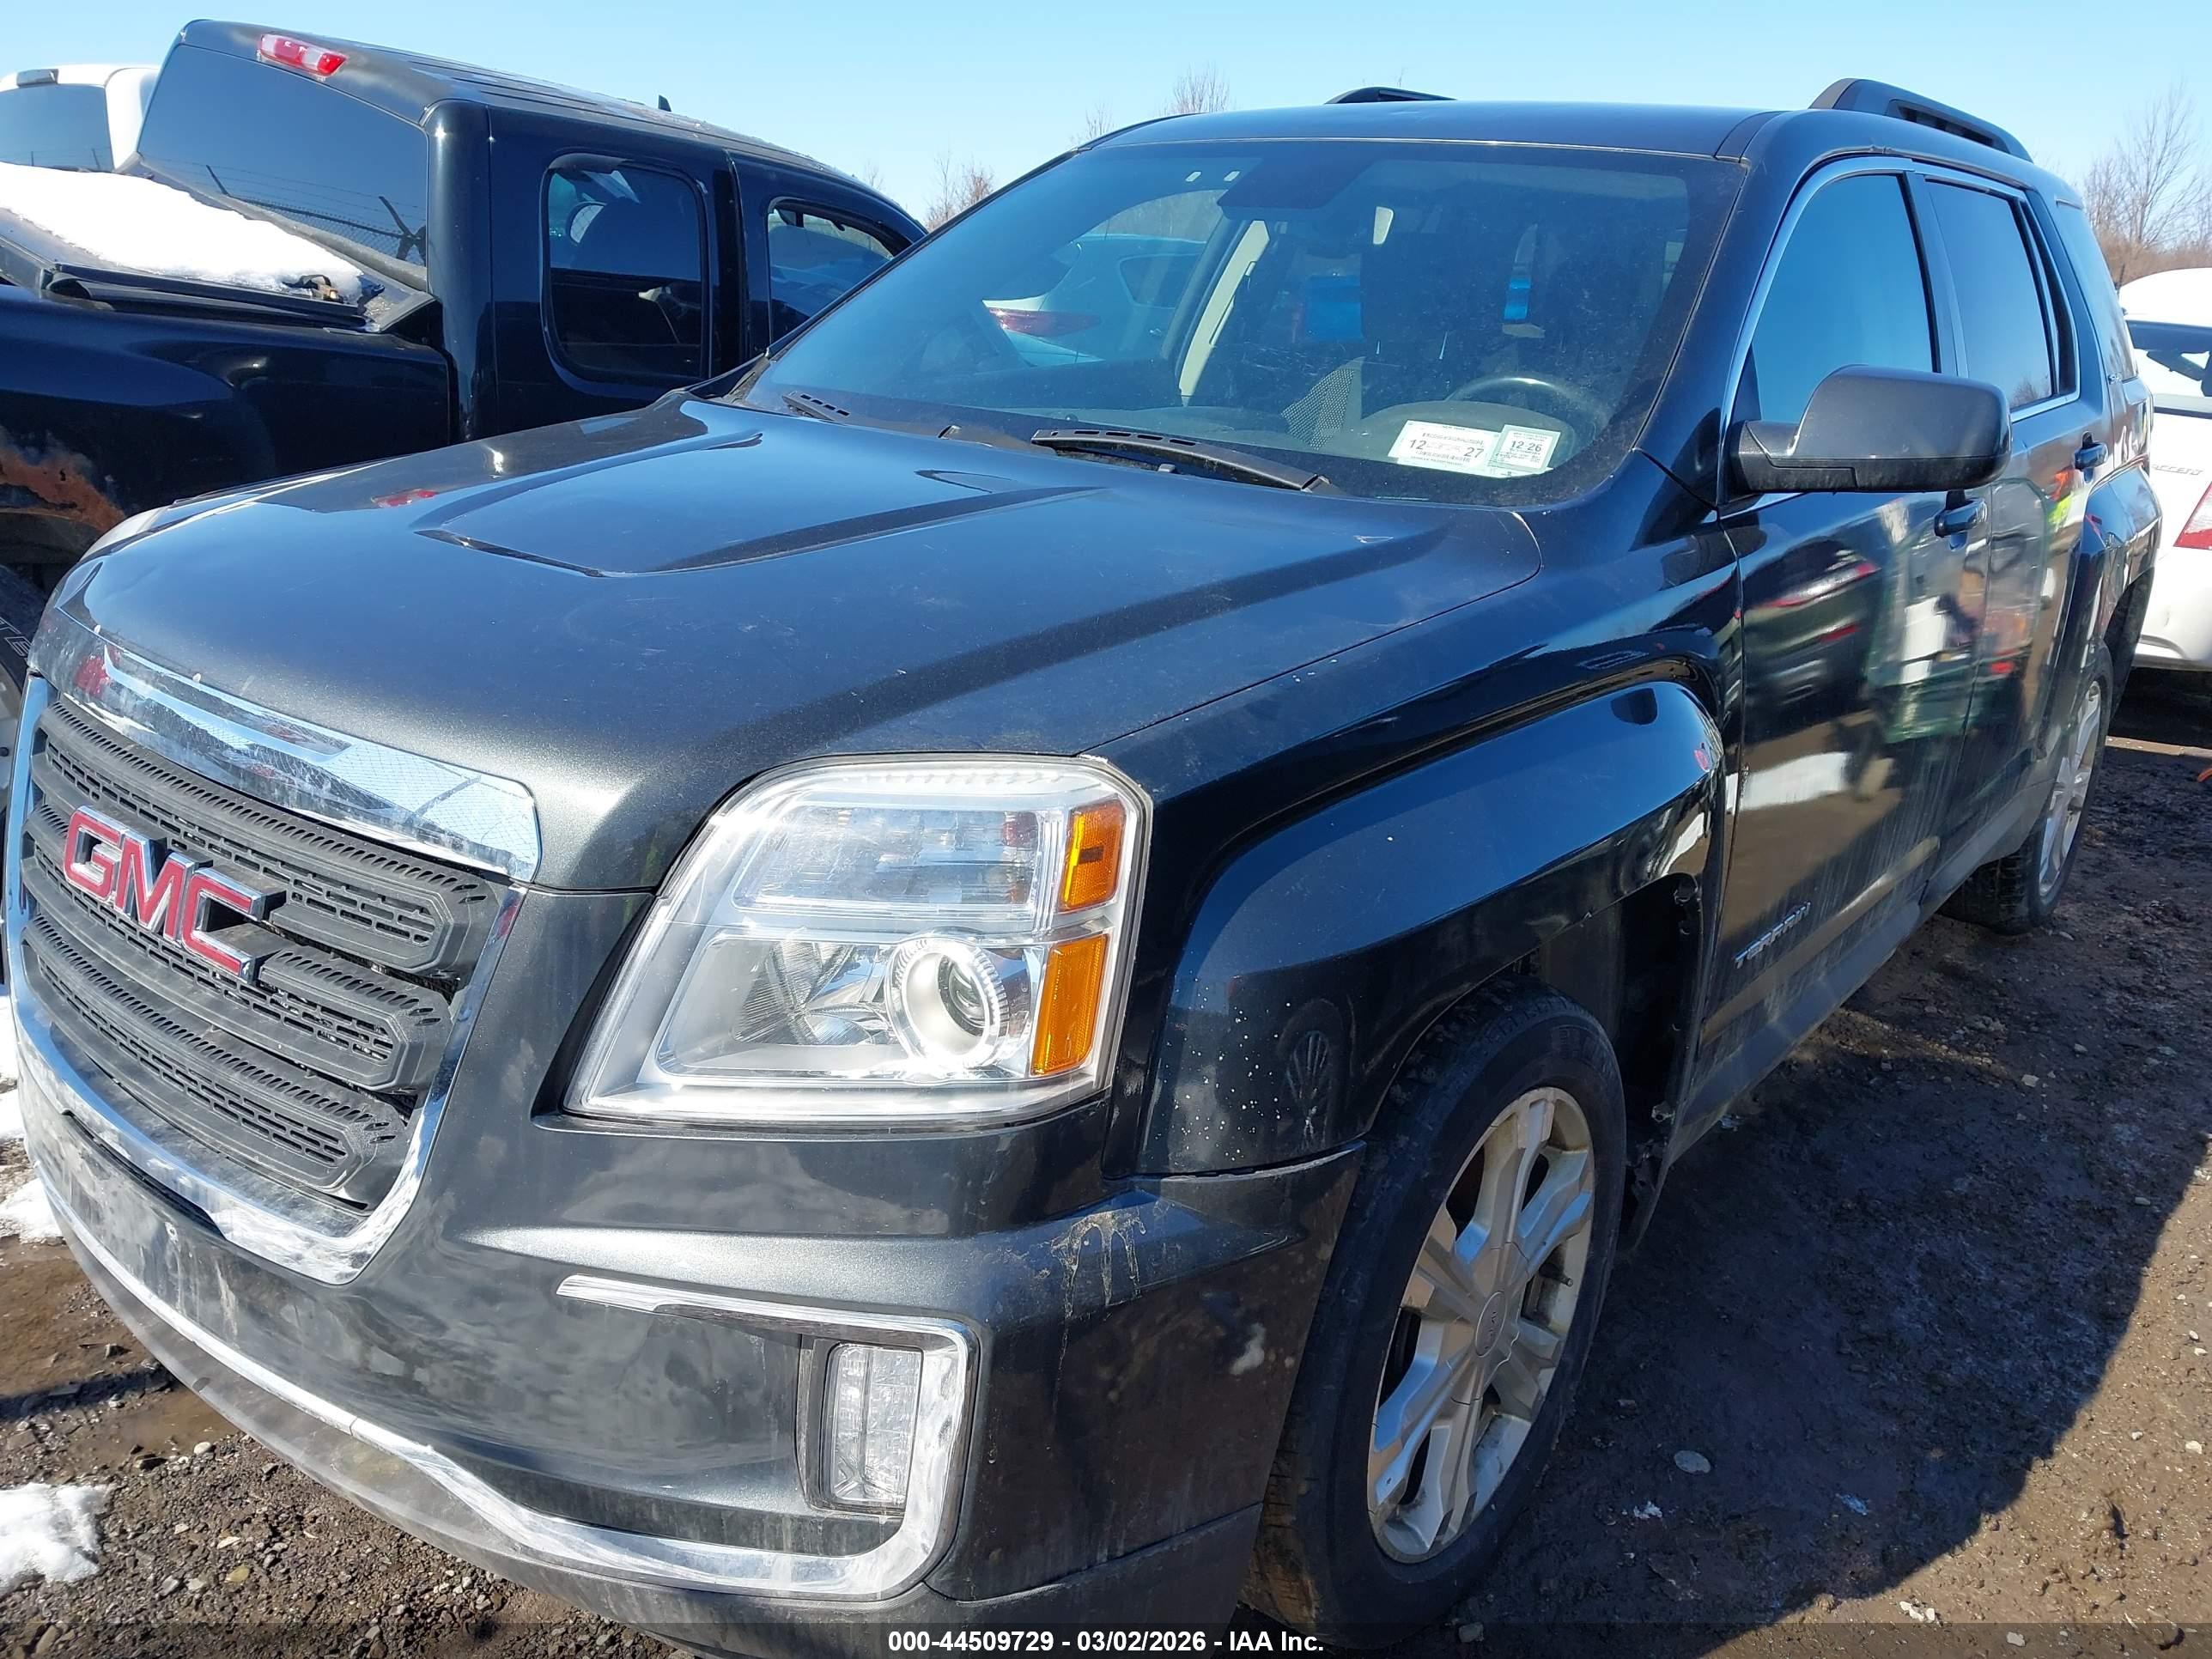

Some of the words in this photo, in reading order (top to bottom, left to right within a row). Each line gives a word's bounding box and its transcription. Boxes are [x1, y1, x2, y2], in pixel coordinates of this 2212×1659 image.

[1409, 439, 1427, 450] 12
[1463, 447, 1485, 459] 27
[63, 805, 268, 985] GMC
